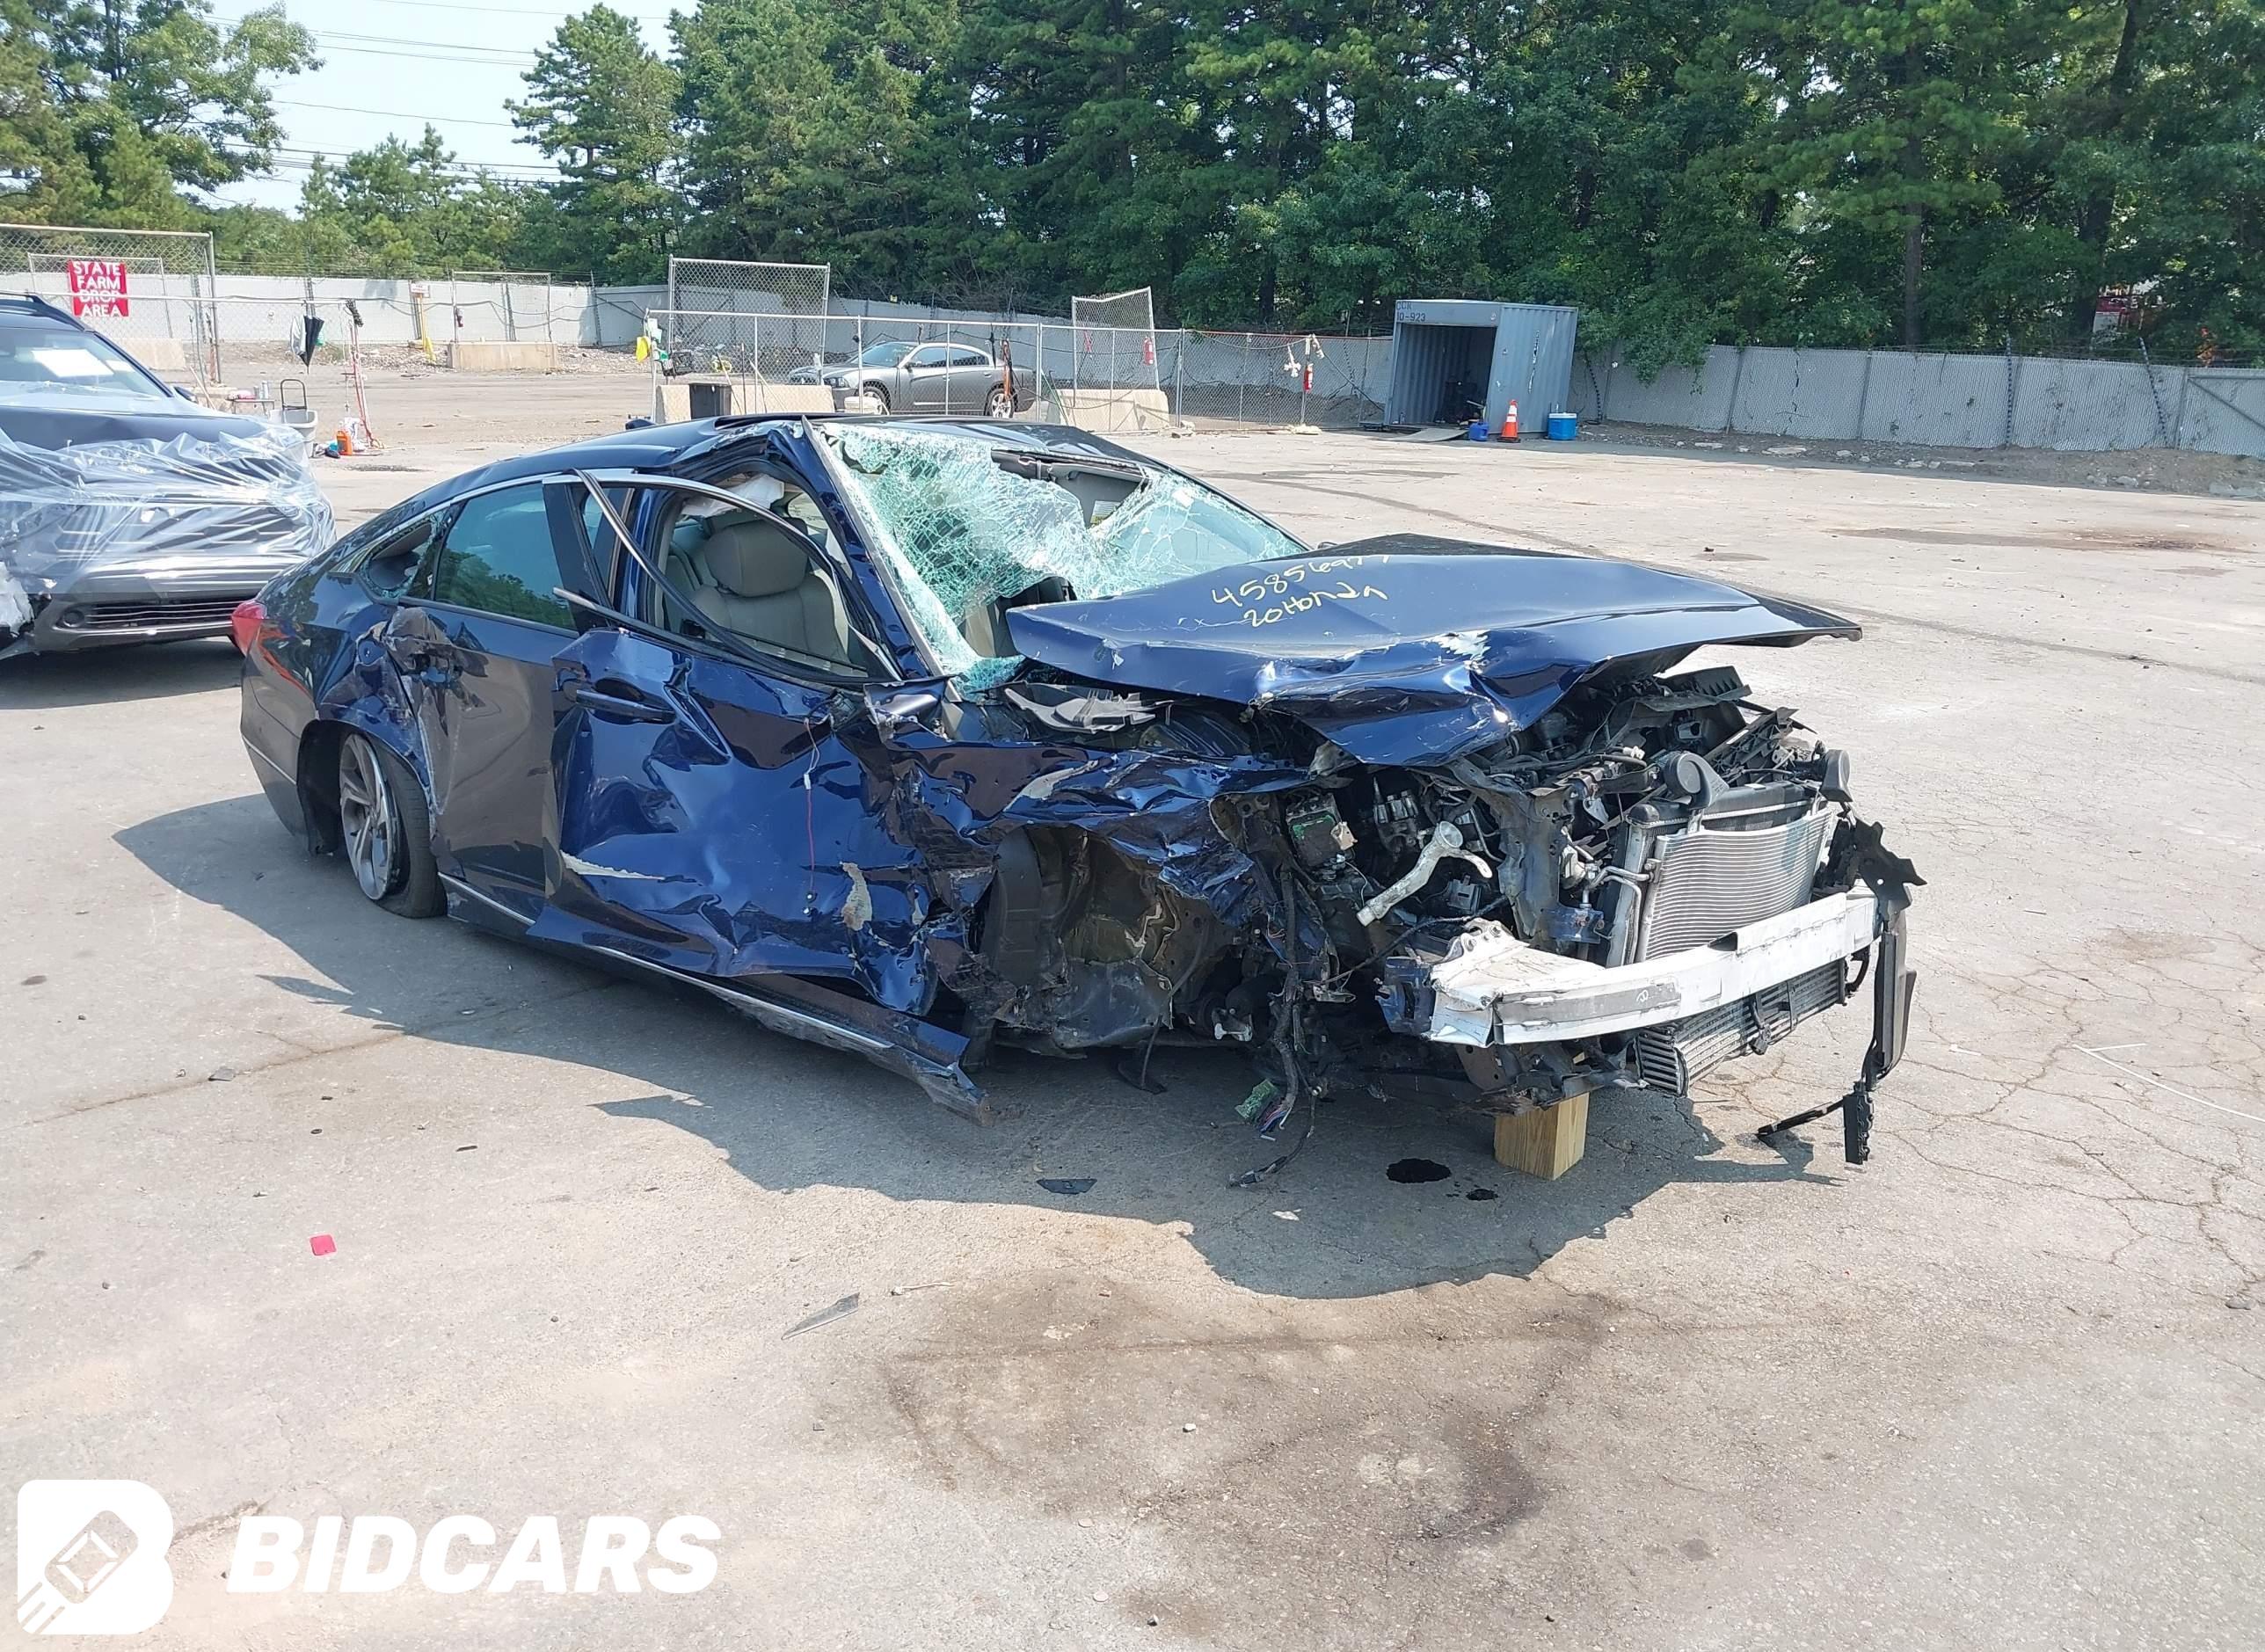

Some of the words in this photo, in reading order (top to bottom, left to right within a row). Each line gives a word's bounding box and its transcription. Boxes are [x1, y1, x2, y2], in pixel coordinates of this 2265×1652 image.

[73, 260, 121, 275] STATE
[77, 276, 120, 289] FARM
[79, 289, 120, 303] DROP
[82, 304, 122, 317] AREA
